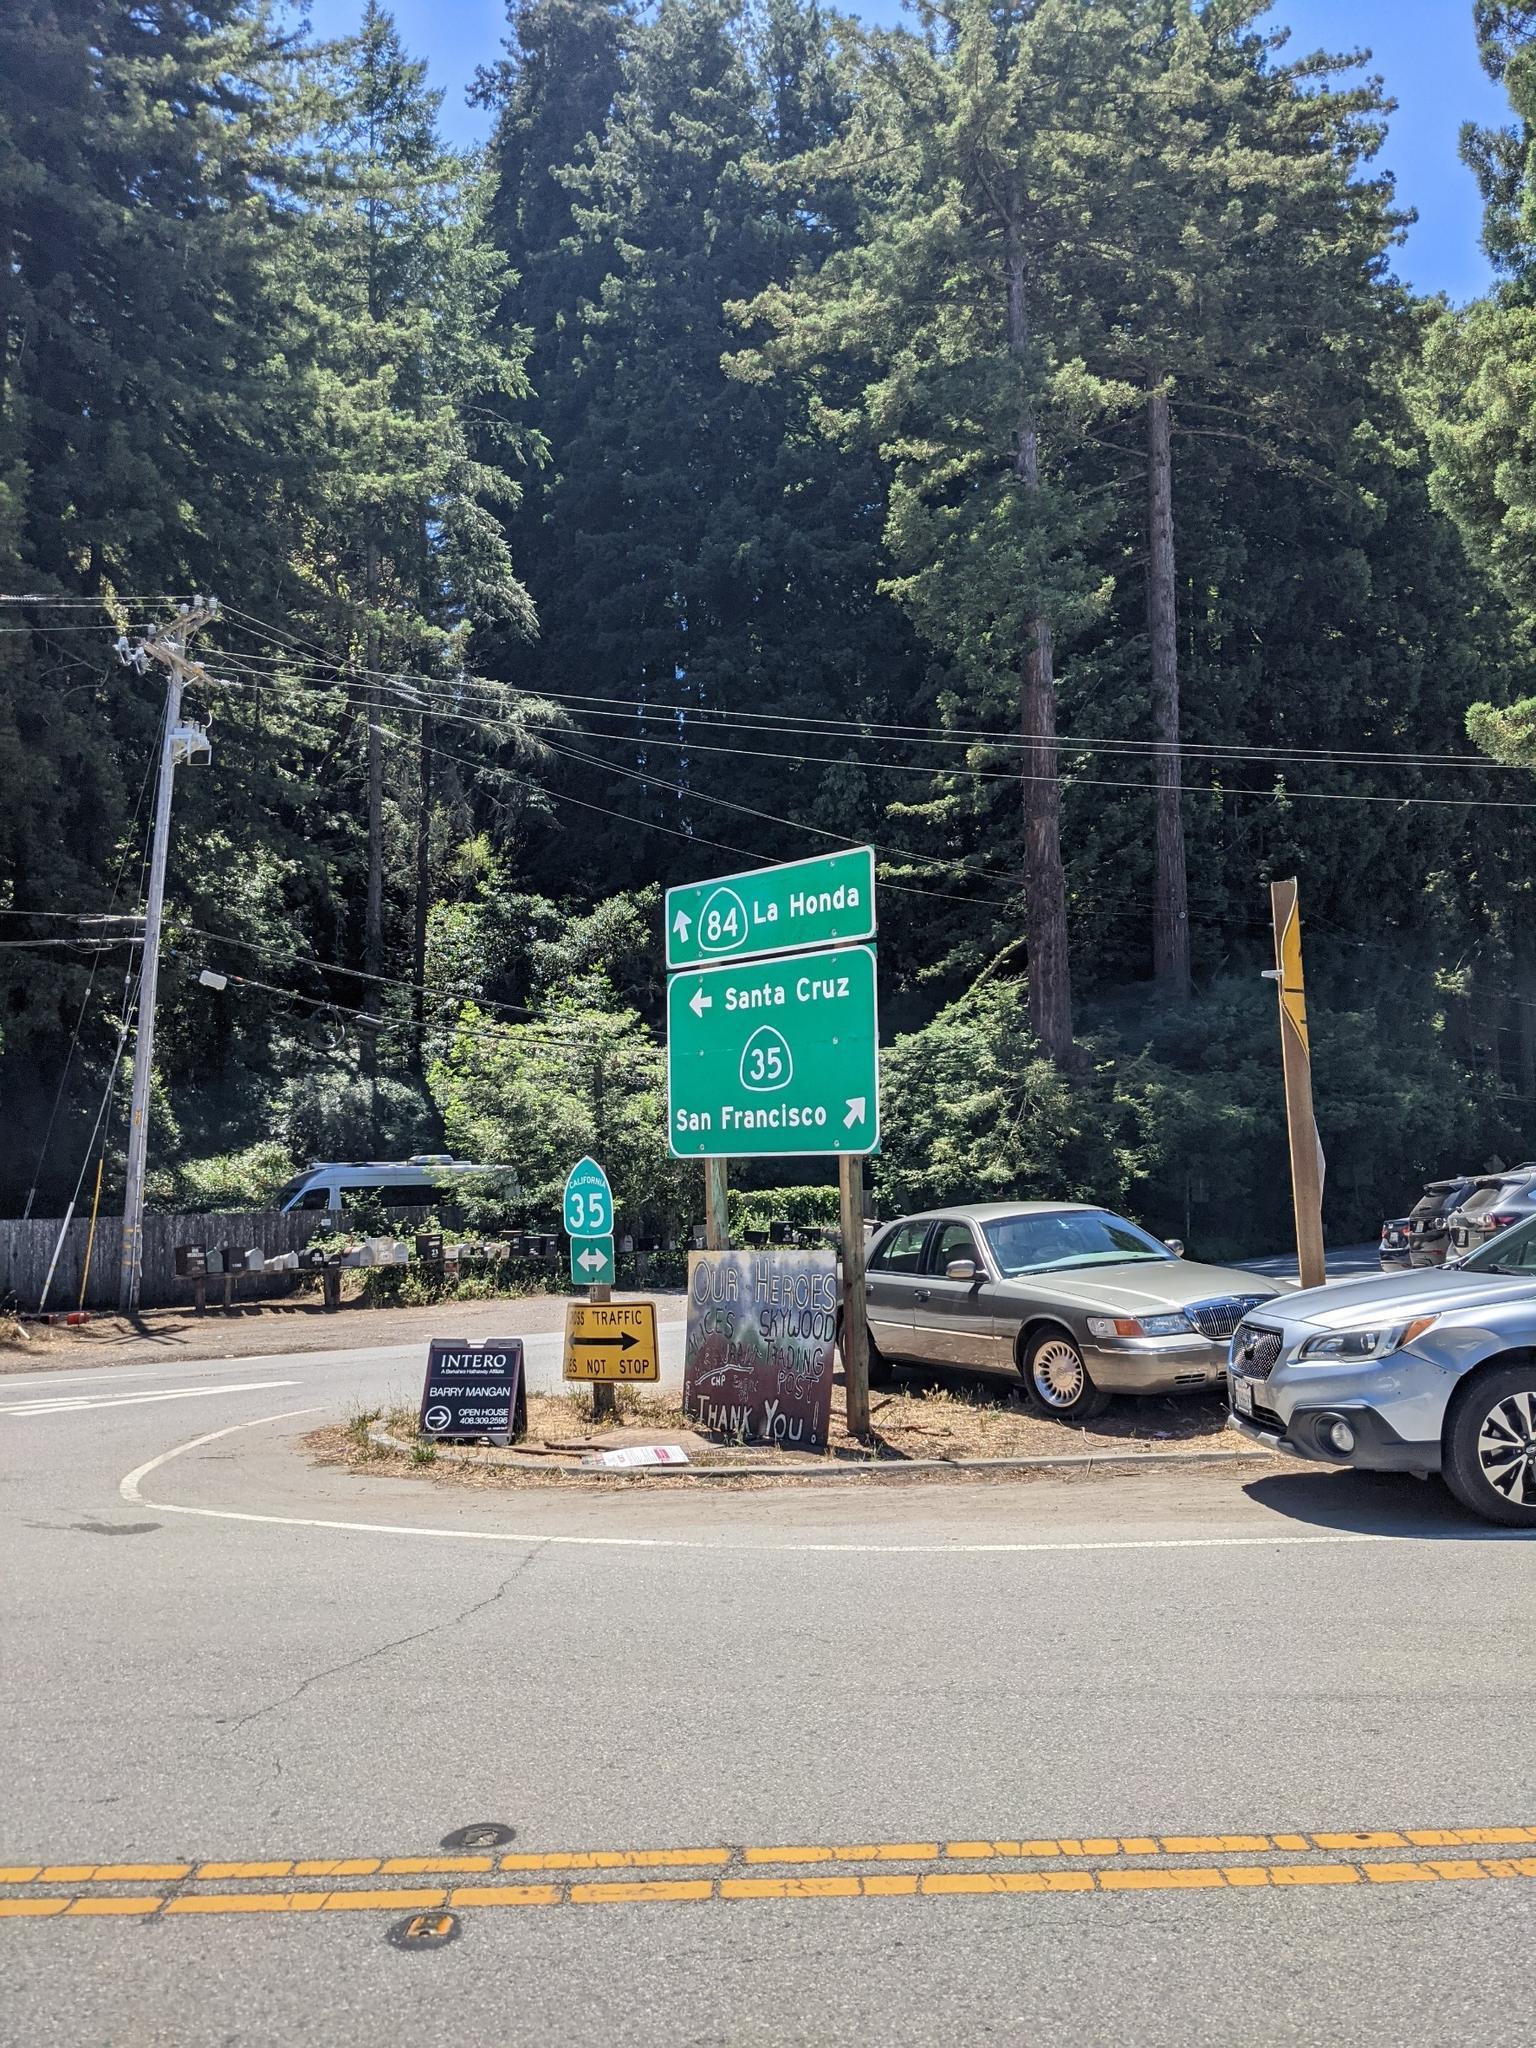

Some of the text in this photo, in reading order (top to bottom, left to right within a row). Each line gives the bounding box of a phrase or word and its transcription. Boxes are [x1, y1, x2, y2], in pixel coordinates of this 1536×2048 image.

[707, 884, 860, 941] 84 La Honda
[725, 977, 850, 1011] Santa Cruz
[750, 1046, 783, 1081] 35
[676, 1103, 827, 1132] San Francisco
[569, 1175, 606, 1189] CALIFORNIA
[569, 1193, 605, 1229] 35
[693, 1257, 837, 1315] OUR HEROES
[593, 1310, 642, 1326] TRAFFIC
[758, 1308, 836, 1343] SKYWOOD
[441, 1354, 507, 1368] INTERO
[586, 1359, 607, 1375] NOT
[619, 1359, 650, 1375] STOP
[763, 1338, 825, 1377] TRADING
[429, 1386, 511, 1397] BARRY MANGAN
[711, 1374, 726, 1387] CHP
[777, 1369, 820, 1404] POST
[458, 1408, 510, 1416] OPEN HOUSE
[697, 1394, 753, 1436] THANK
